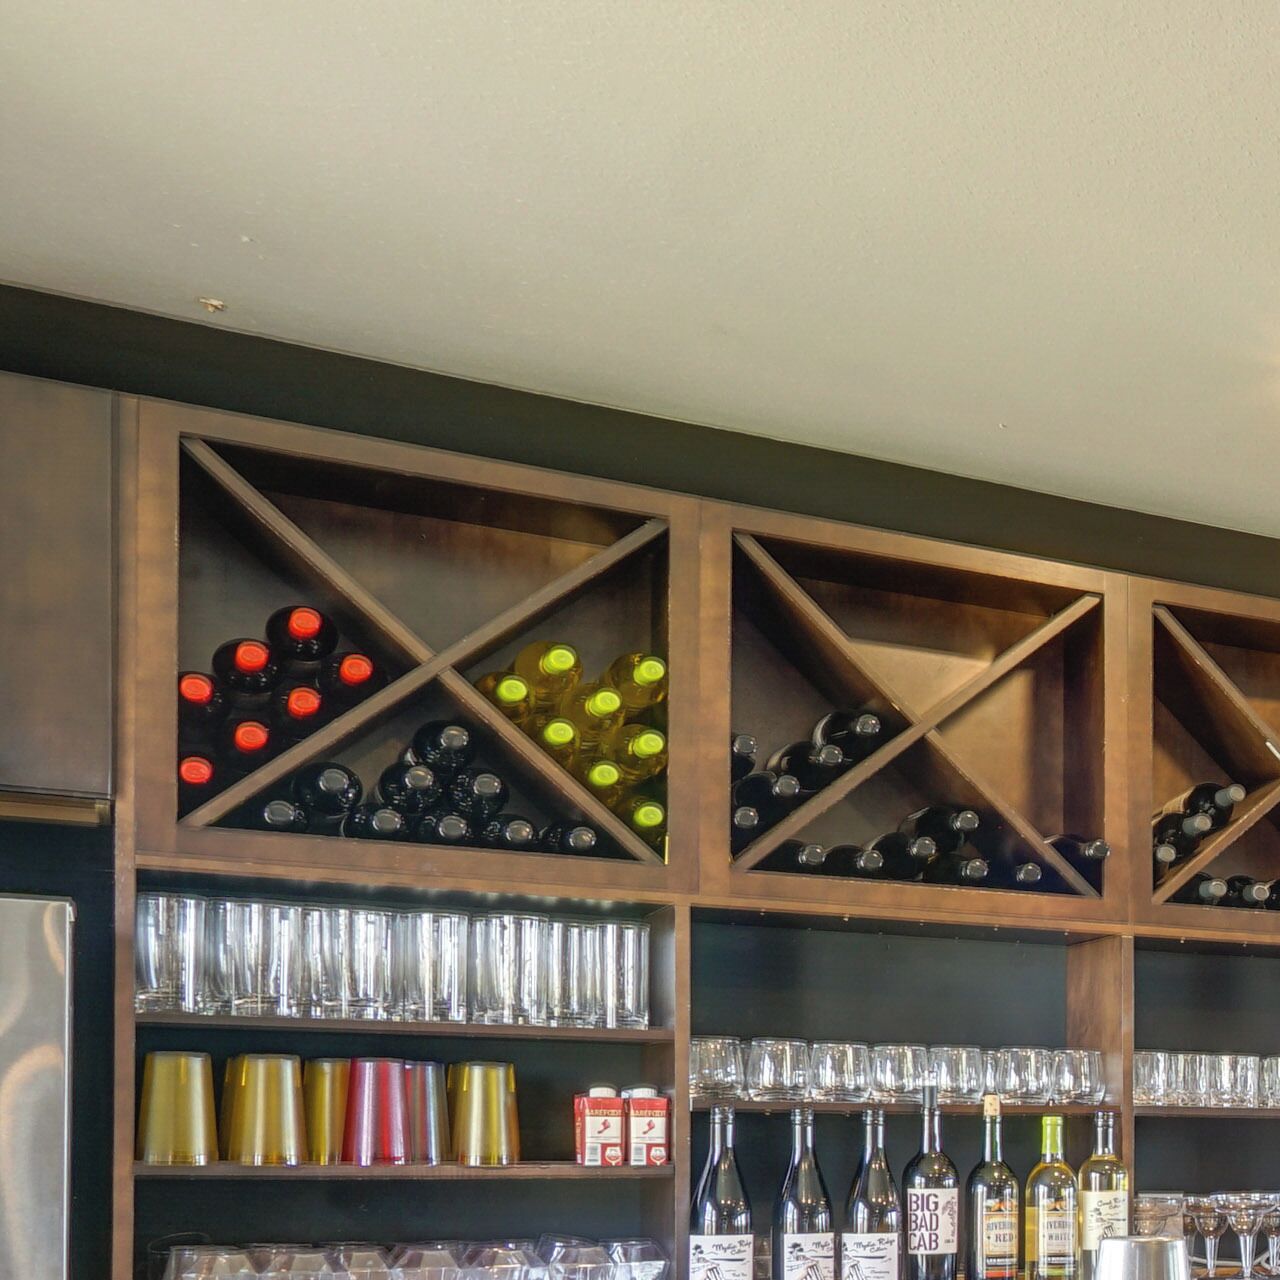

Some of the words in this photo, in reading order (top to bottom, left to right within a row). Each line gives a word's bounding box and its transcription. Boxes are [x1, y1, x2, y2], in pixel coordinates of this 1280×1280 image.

[909, 1193, 939, 1213] BIG
[909, 1212, 939, 1232] BAD
[909, 1232, 939, 1251] CAB
[995, 1232, 1014, 1243] RED
